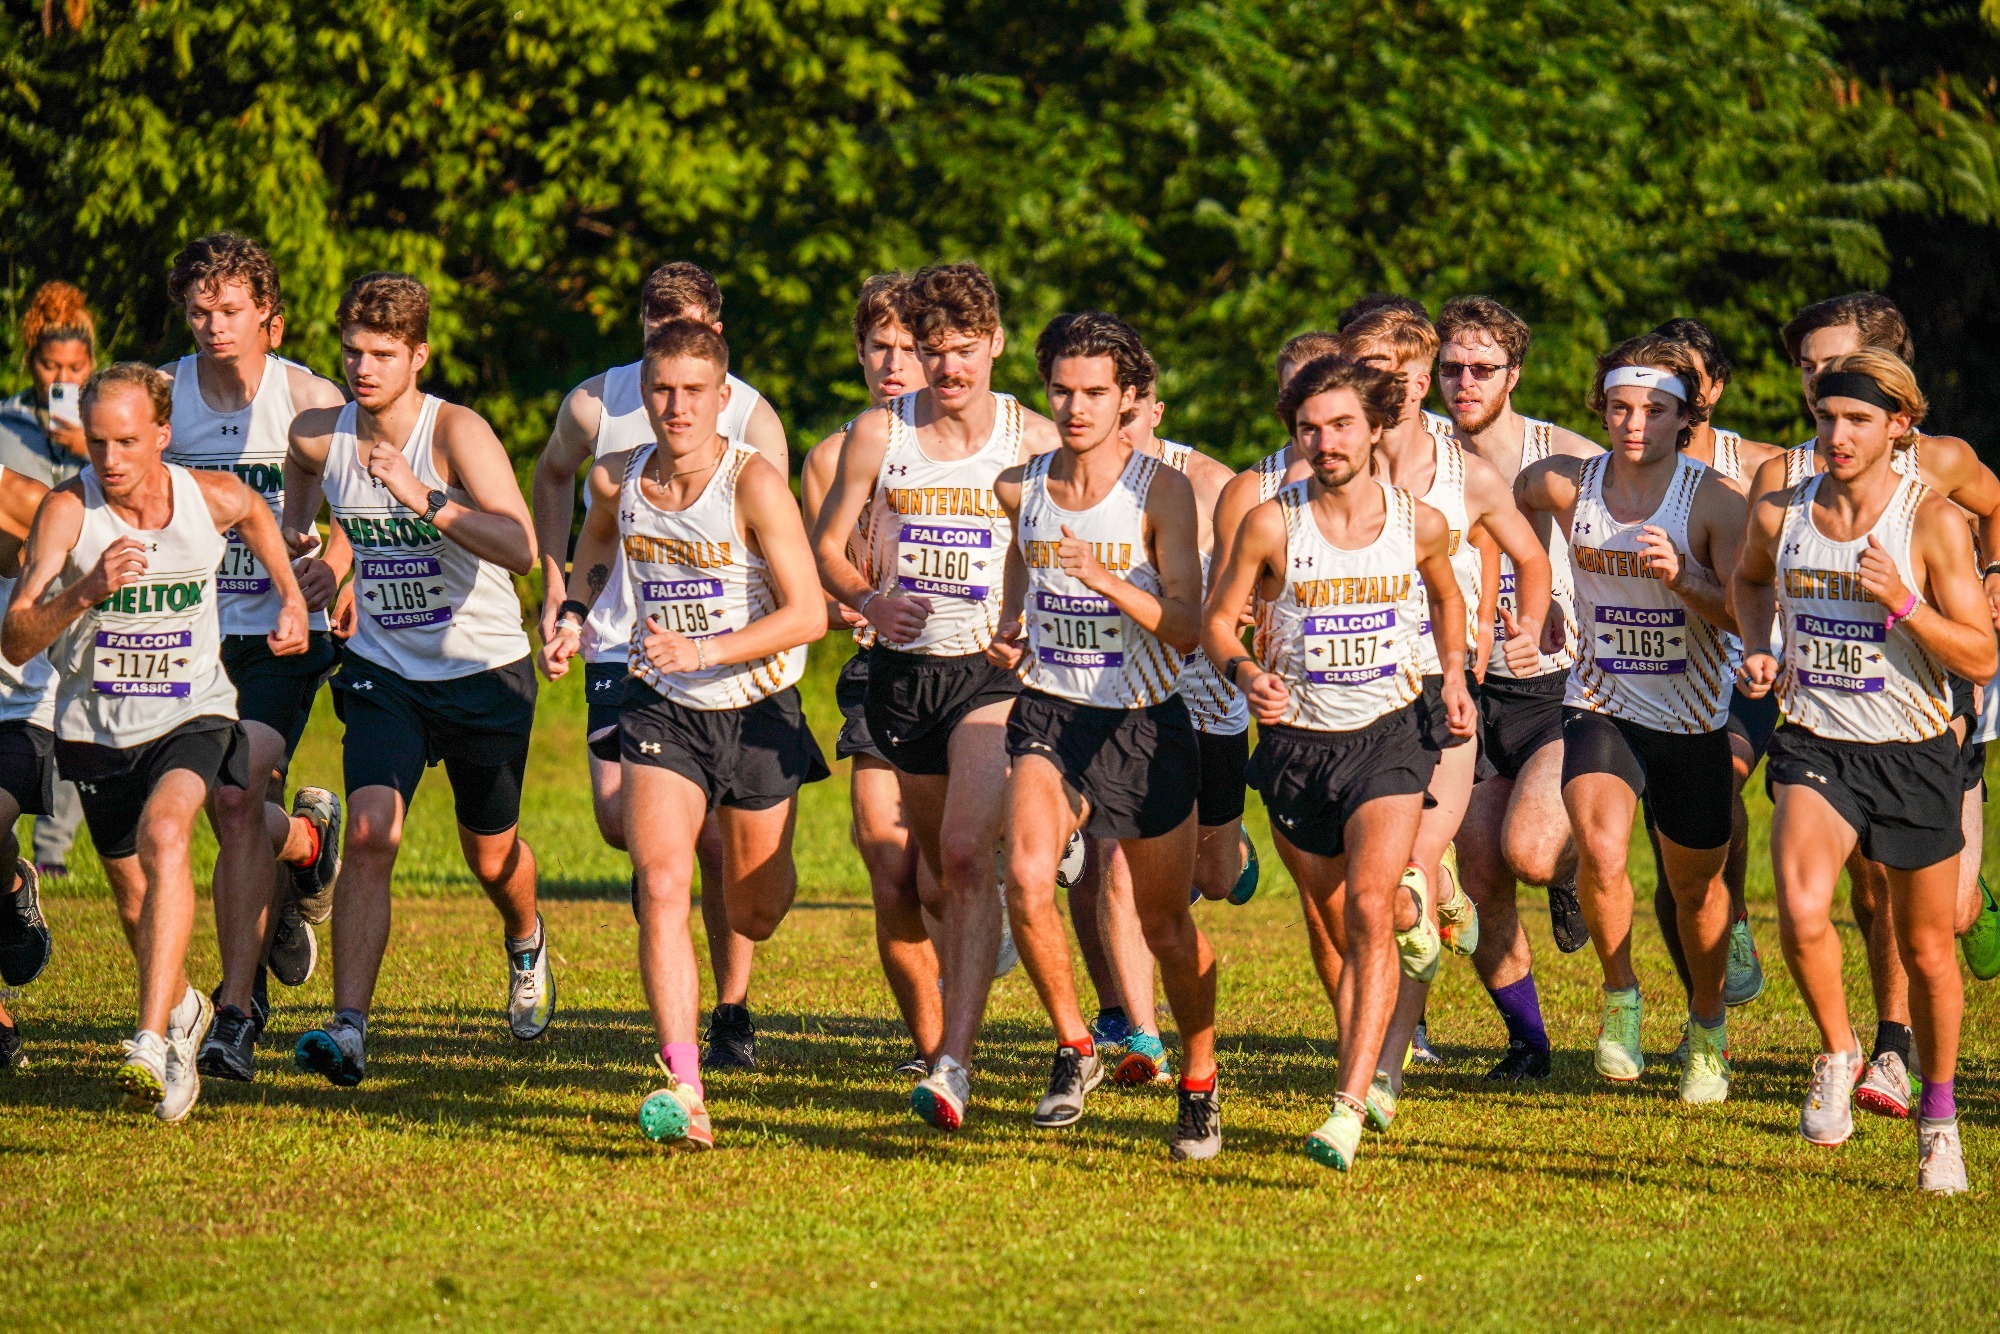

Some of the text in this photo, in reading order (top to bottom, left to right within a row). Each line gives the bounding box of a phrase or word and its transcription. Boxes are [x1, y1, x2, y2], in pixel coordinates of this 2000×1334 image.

[910, 529, 982, 545] FALCON
[623, 534, 734, 568] MONTEVALLO
[219, 548, 254, 576] 173
[367, 562, 430, 576] FALCON
[919, 548, 969, 581] 1160
[217, 580, 259, 591] ASSIC
[650, 582, 714, 598] FALCON
[915, 580, 971, 595] CLASSIC
[1294, 574, 1411, 608] MONTEVALLO
[95, 580, 206, 614] HELTON
[378, 581, 427, 611] 1169
[1044, 596, 1109, 613] FALCON
[381, 612, 435, 626] CLASSIC
[661, 603, 709, 633] 1159
[1315, 613, 1388, 633] FALCON
[1605, 609, 1674, 624] FALCON
[1053, 617, 1100, 649] 1161
[1805, 618, 1874, 638] FALCON
[107, 633, 182, 648] FALCON
[1616, 628, 1665, 658] 1163
[1054, 651, 1106, 664] CLASSIC
[1328, 636, 1377, 667] 1157
[1812, 640, 1862, 674] 1146
[117, 653, 169, 678] 1174
[1613, 660, 1669, 671] CLASSIC
[1324, 668, 1381, 682] CLASSIC
[1808, 674, 1865, 689] CLASSIC
[112, 683, 172, 693] CLASSIC
